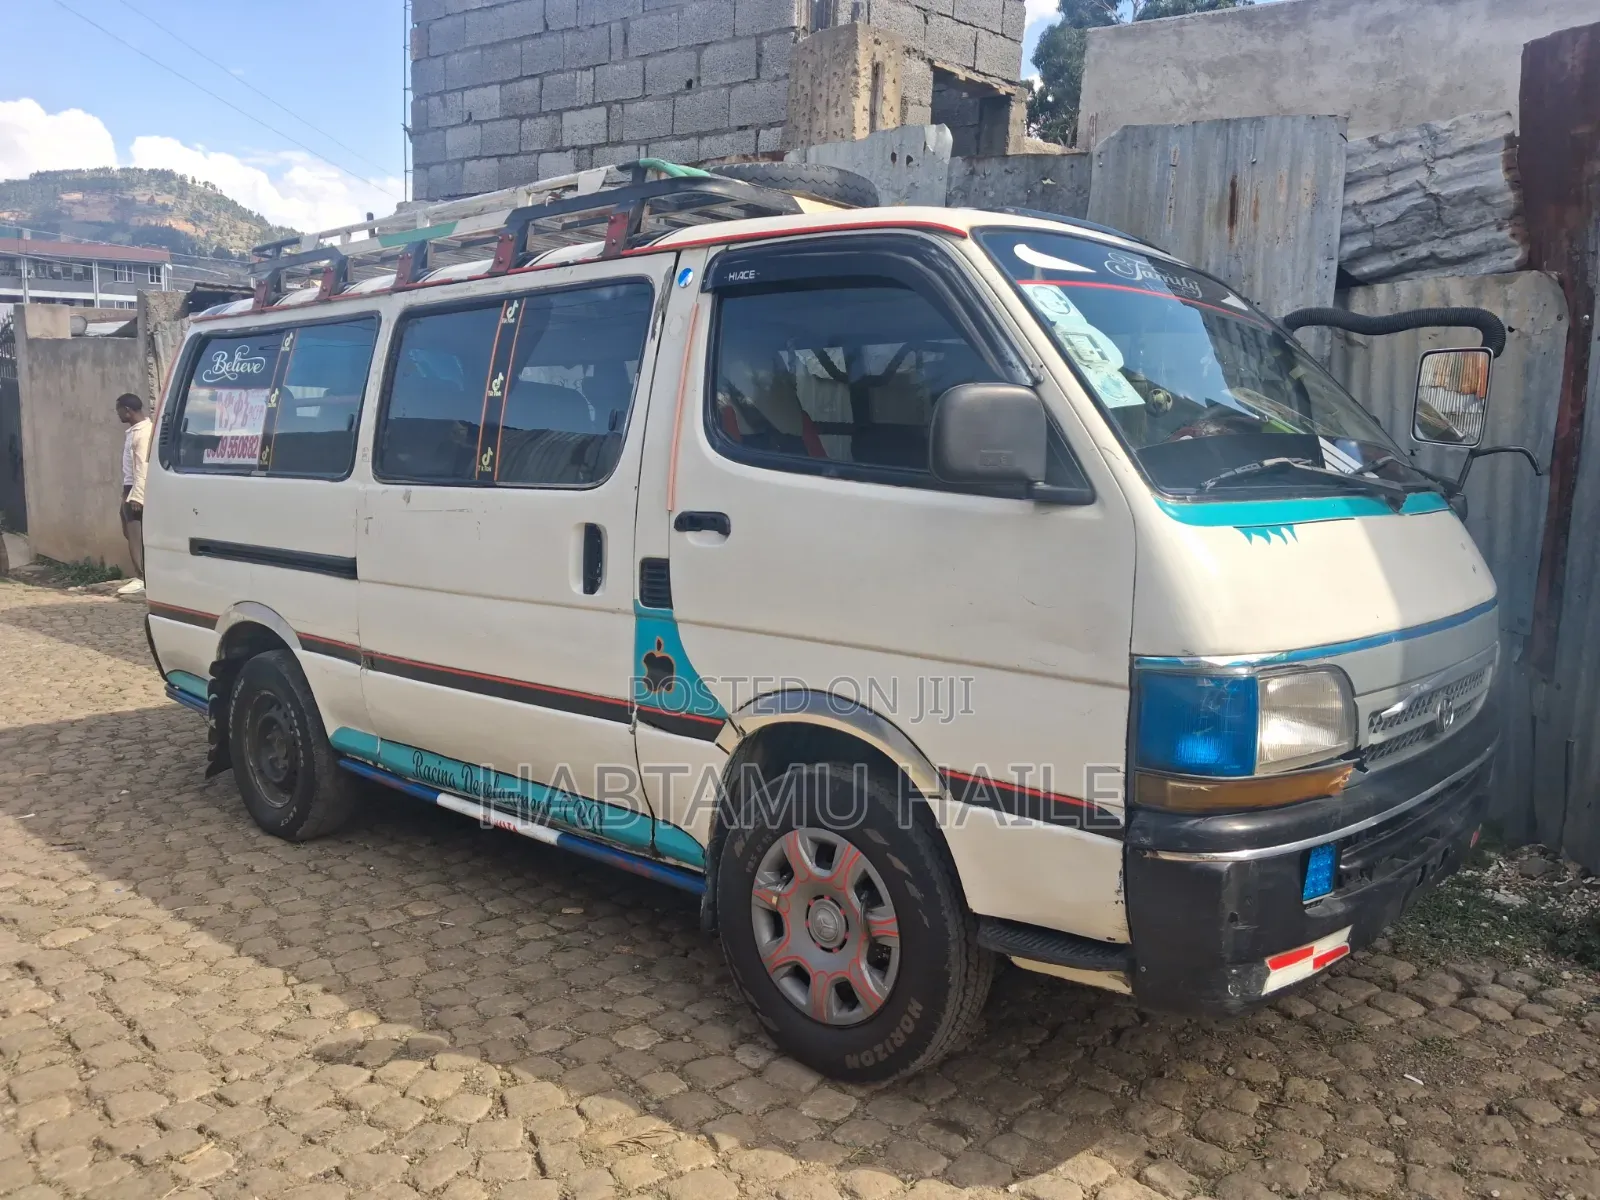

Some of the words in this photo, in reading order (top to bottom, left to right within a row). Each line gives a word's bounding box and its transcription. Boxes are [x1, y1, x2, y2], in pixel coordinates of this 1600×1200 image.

[728, 269, 756, 281] HIACE
[1104, 252, 1202, 298] Family
[202, 344, 266, 383] Believe
[844, 996, 924, 1069] HORIZON
